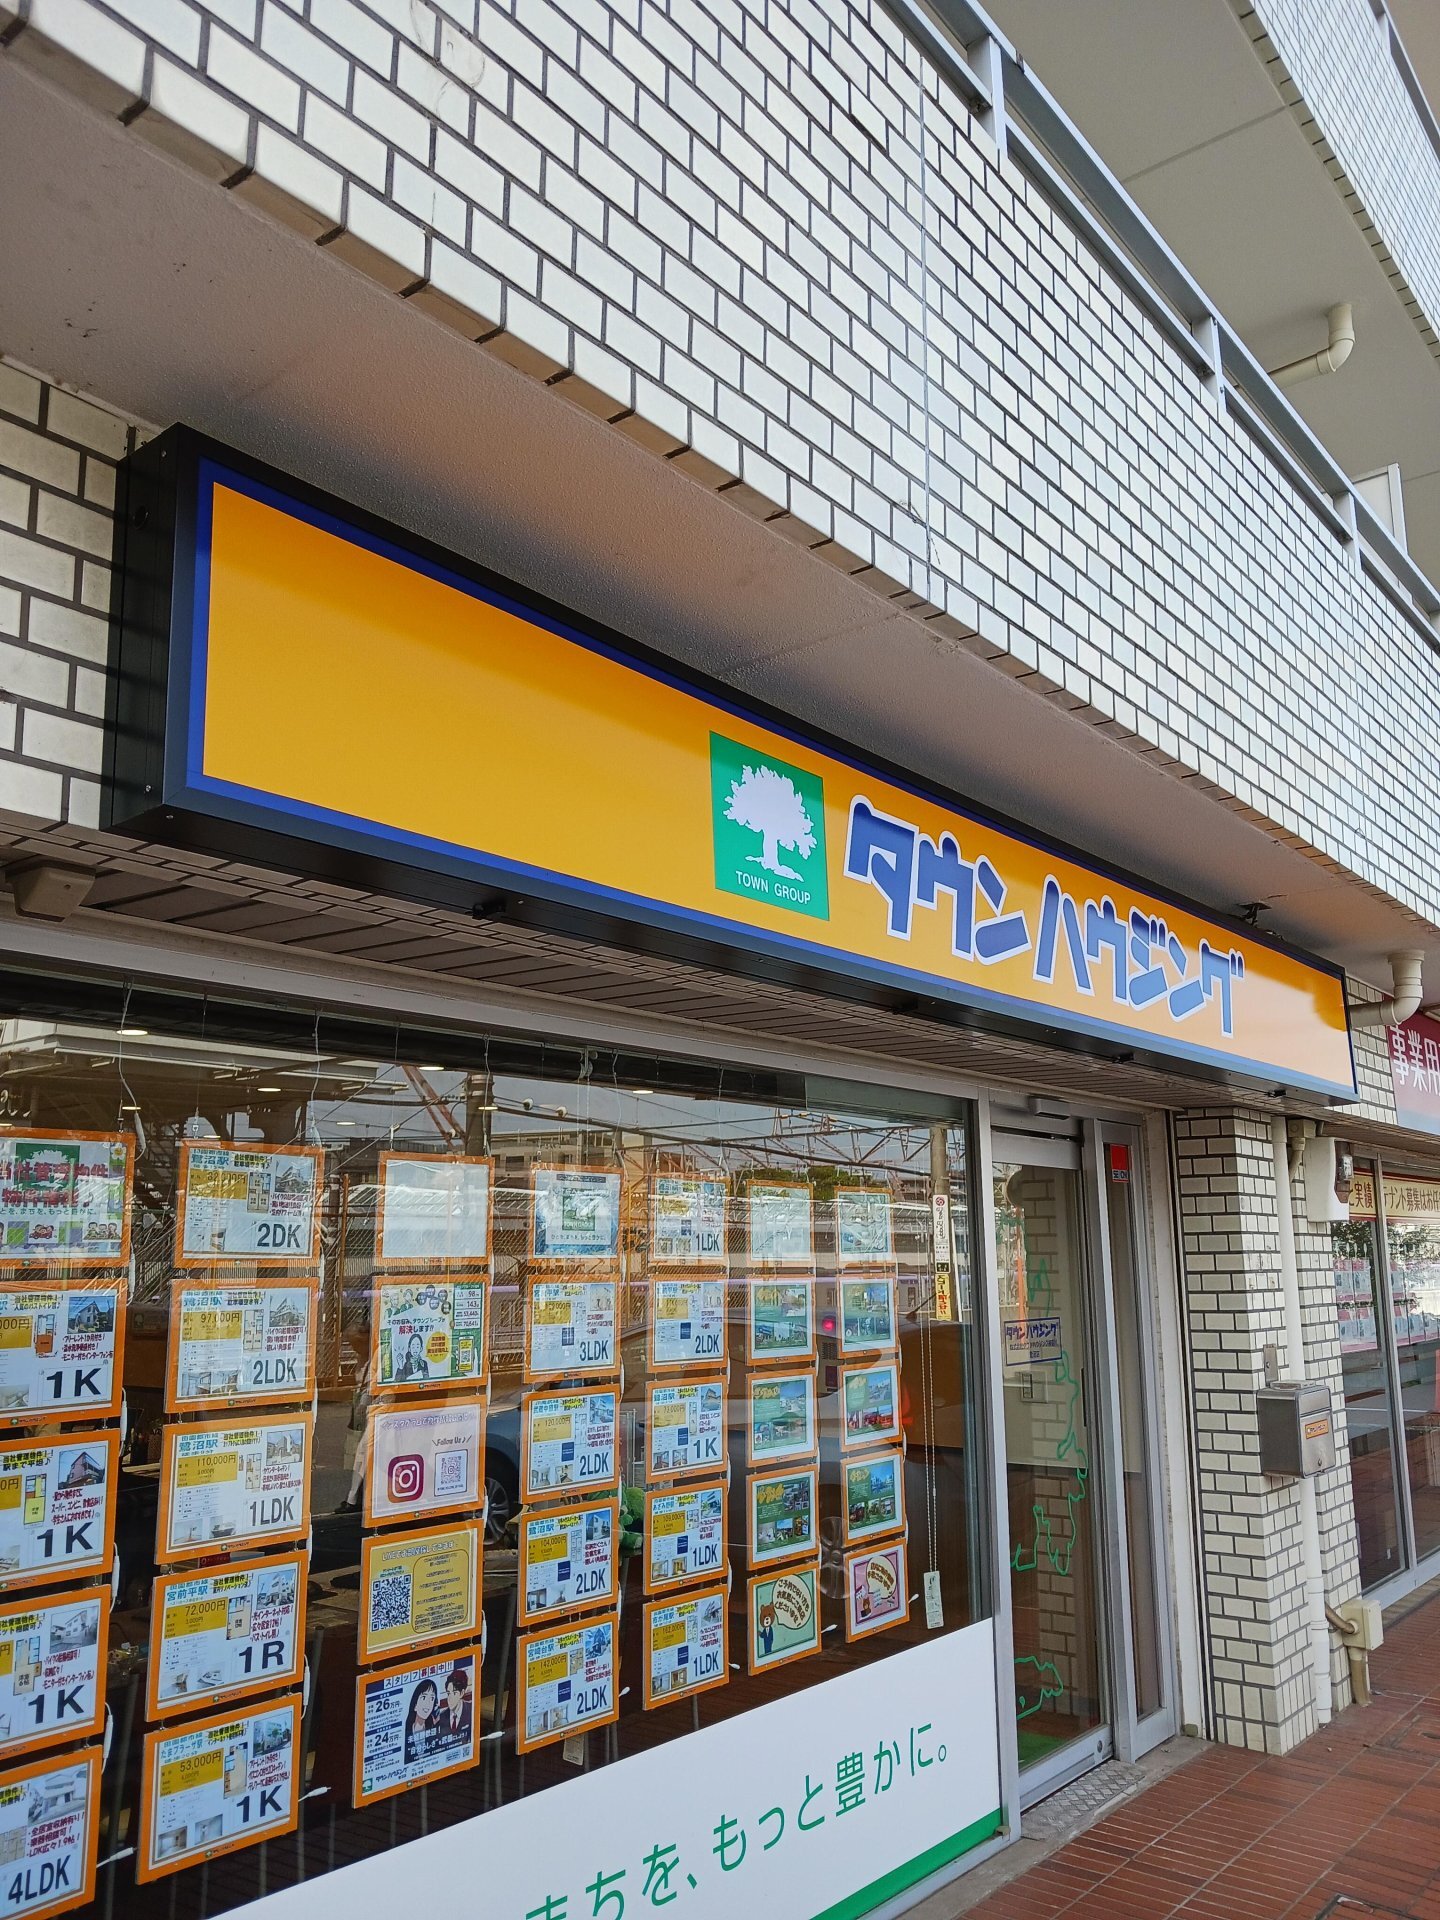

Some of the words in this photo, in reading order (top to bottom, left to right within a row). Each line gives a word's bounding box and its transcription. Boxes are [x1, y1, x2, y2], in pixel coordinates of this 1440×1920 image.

[735, 870, 769, 893] TOWN
[774, 882, 811, 905] GROUP
[843, 795, 1245, 1038] タウンハウジング
[257, 1223, 301, 1249] 2DK
[696, 1233, 720, 1252] 1LDK
[579, 1339, 609, 1362] 3LDK
[695, 1334, 720, 1354] 2LDK
[252, 1357, 297, 1385] 2LDK
[579, 1452, 609, 1477] 2LDK
[249, 1495, 294, 1527] 1LDK
[693, 1543, 718, 1568] 1LDK
[576, 1567, 606, 1595] 2LDK
[185, 1600, 227, 1617] 72,000円
[693, 1650, 719, 1677] 1LDK
[576, 1684, 608, 1715] 2LDK
[180, 1751, 222, 1773] 53,000円
[8, 1855, 71, 1905] 4LDK
